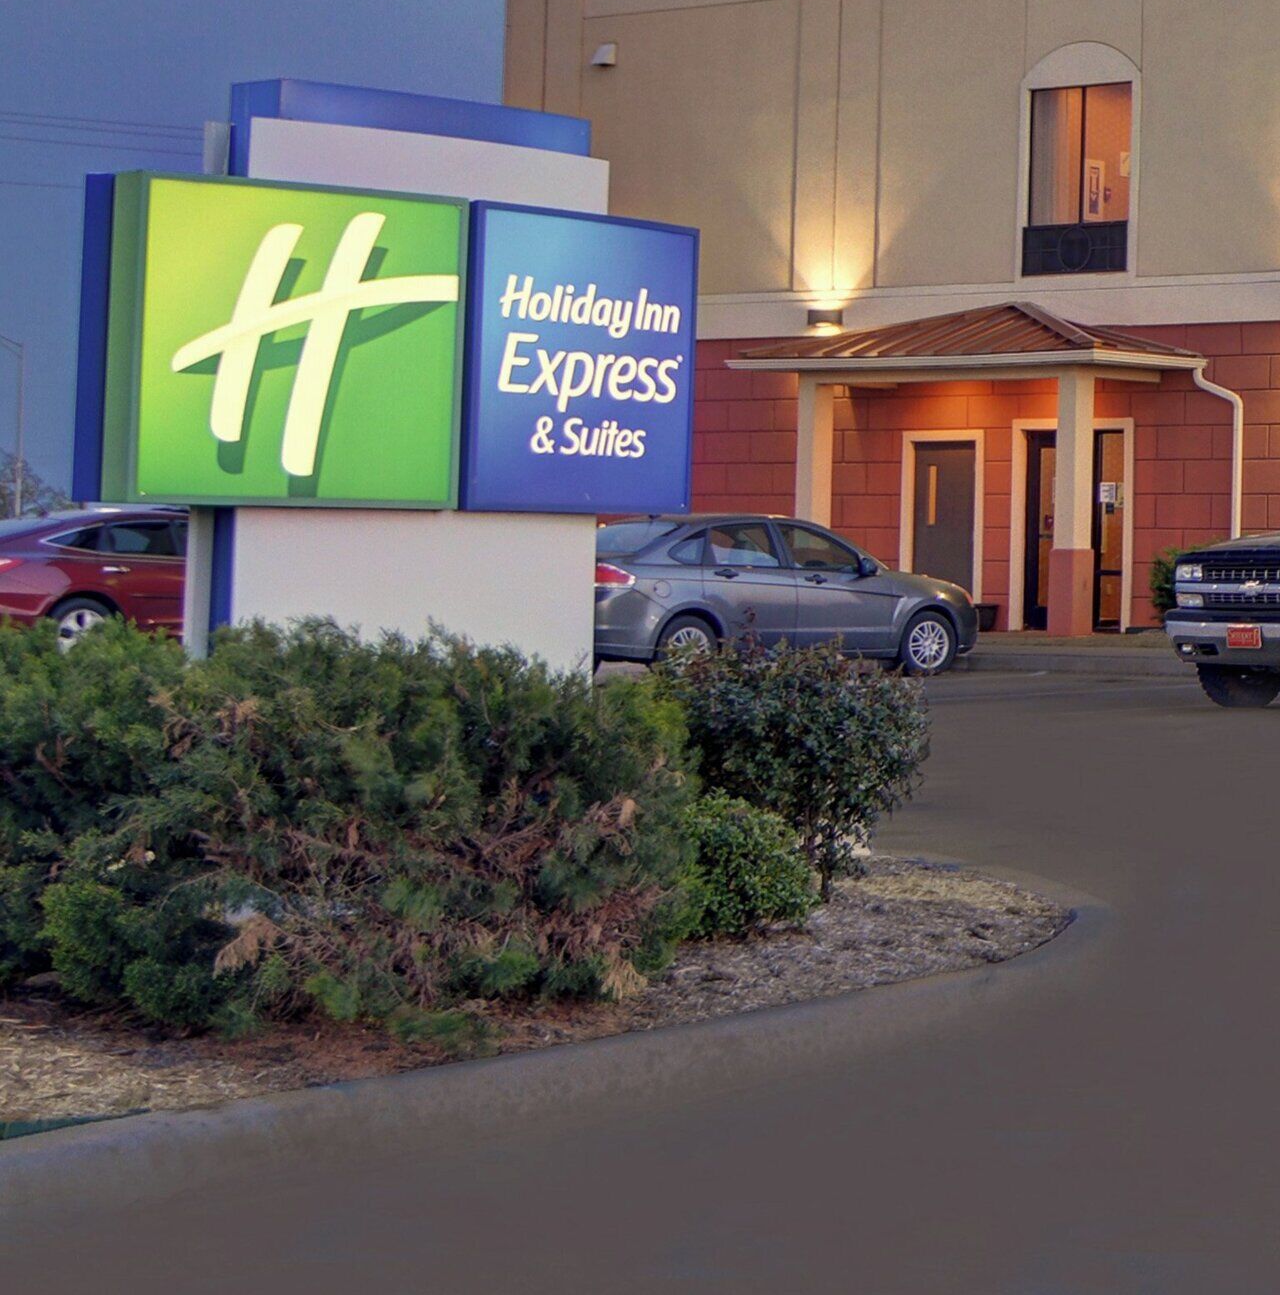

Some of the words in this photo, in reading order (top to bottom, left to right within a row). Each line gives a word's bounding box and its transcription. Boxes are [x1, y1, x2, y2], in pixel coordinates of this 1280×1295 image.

[499, 274, 633, 339] Holiday
[634, 288, 681, 334] Inn
[498, 332, 677, 413] Express
[530, 415, 555, 454] &
[560, 417, 647, 458] Suites
